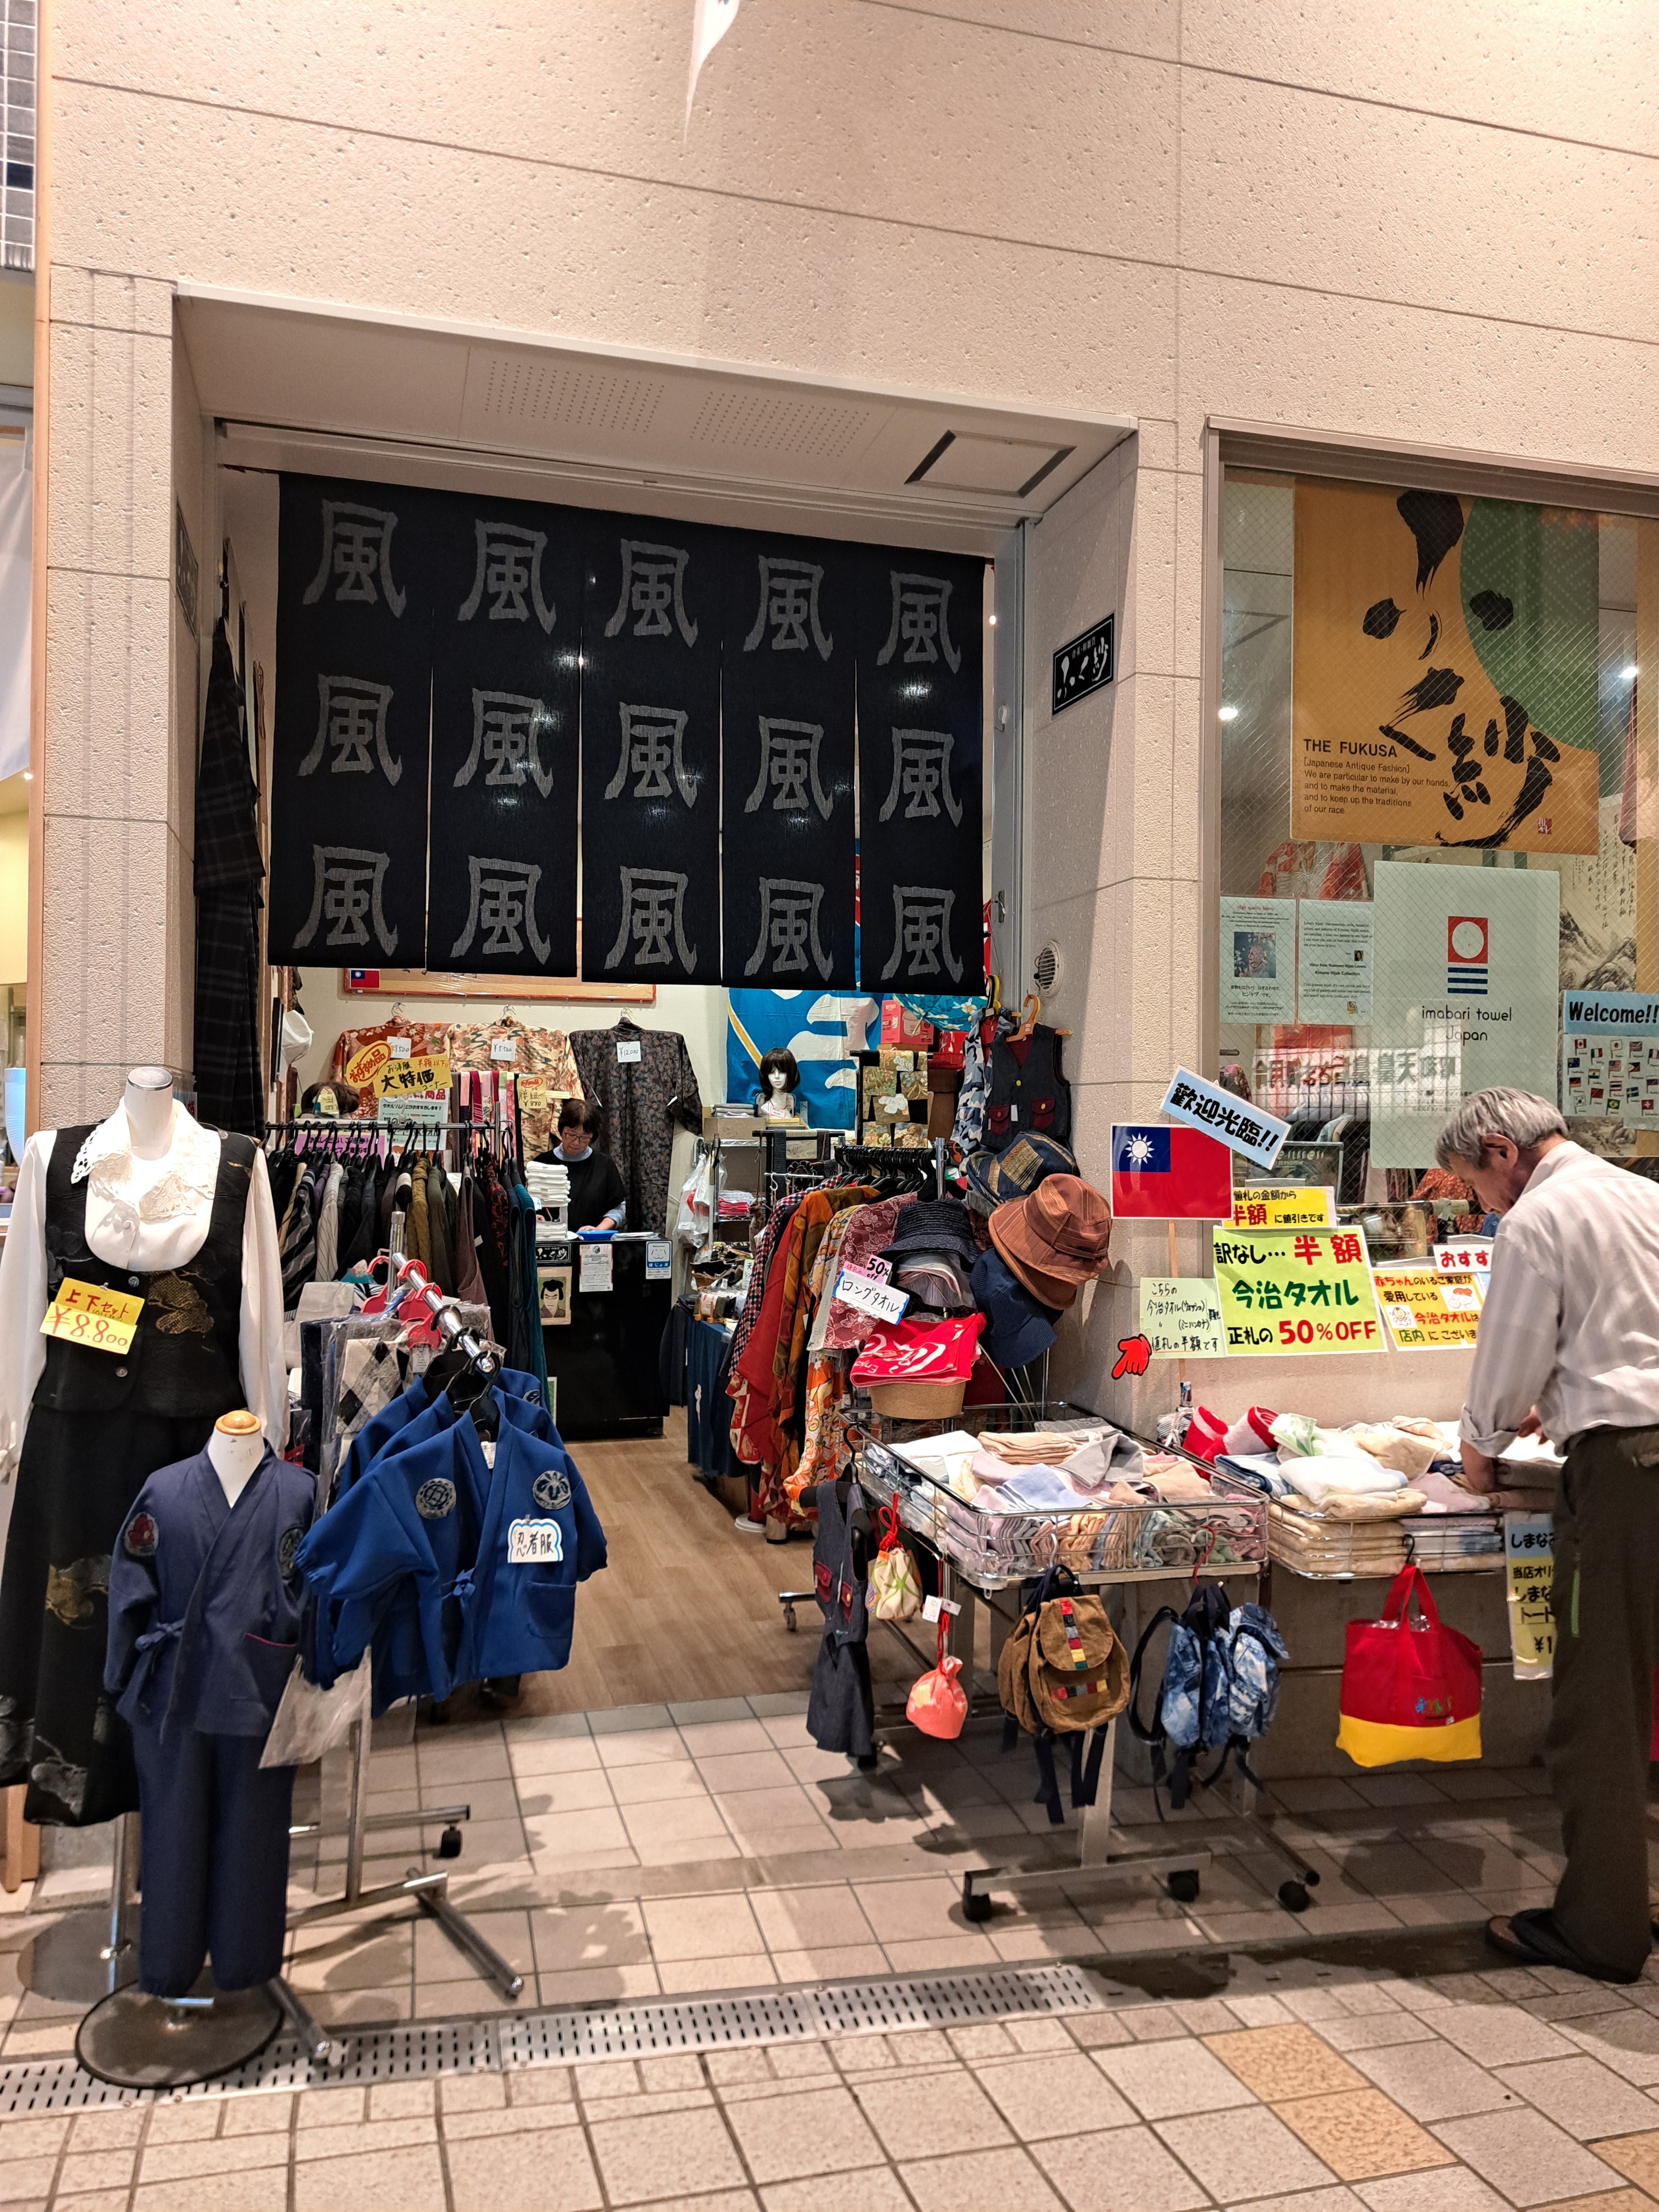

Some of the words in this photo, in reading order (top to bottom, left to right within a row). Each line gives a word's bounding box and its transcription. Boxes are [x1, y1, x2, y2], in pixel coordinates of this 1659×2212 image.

[1304, 739, 1331, 752] THE
[1340, 741, 1397, 758] FUKUSA
[1346, 761, 1375, 771] Antique
[1305, 770, 1316, 778] We
[1334, 773, 1368, 782] particular
[1402, 777, 1410, 785] by
[1427, 778, 1450, 787] hands,
[1367, 786, 1398, 795] material,
[1330, 795, 1348, 804] keep
[1376, 798, 1412, 807] traditions
[1422, 1005, 1470, 1020] imabari
[1476, 1007, 1511, 1021] towel
[1569, 1002, 1659, 1023] Welcome!!
[1446, 1026, 1487, 1046] Japan
[350, 1049, 386, 1083] おすすめ品
[387, 1062, 412, 1074] お洋服
[381, 1069, 434, 1093] 大特価
[1234, 1190, 1296, 1201] 値札の金額から
[1233, 1204, 1268, 1226] 半額
[1275, 1214, 1325, 1224] に値引きです
[1294, 1234, 1363, 1265] 半額
[866, 1258, 890, 1277] 50%
[842, 1280, 900, 1313] ロングタオル
[1152, 1283, 1177, 1296] こちらの
[1232, 1279, 1359, 1310] 今治タオル
[1383, 1291, 1438, 1302] 愛用している
[66, 1289, 129, 1319] 上下セット
[1415, 1312, 1479, 1325] 今治タオルは
[1227, 1326, 1273, 1345] 正札の
[1279, 1319, 1376, 1345] 50%OFF
[1152, 1335, 1218, 1352] 値札の半額です
[516, 1531, 554, 1558] 忍者服
